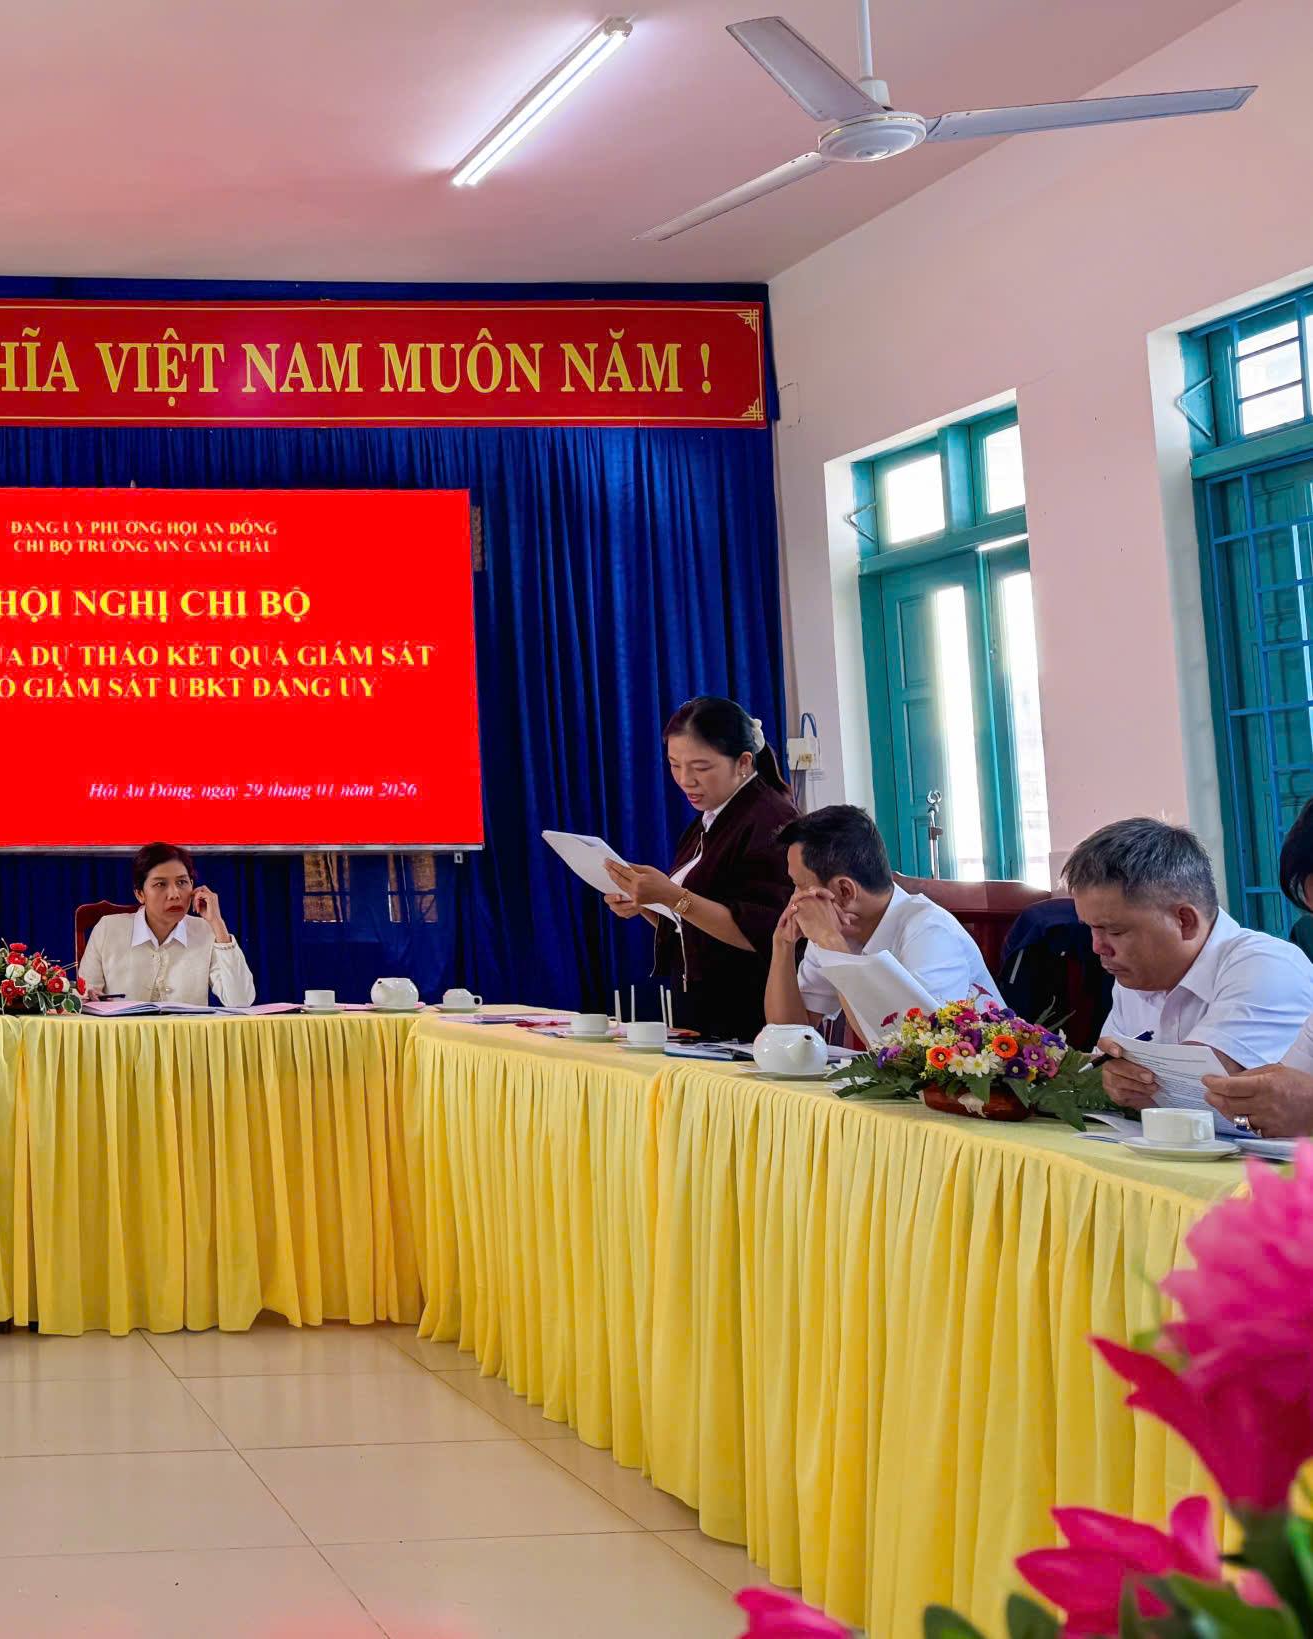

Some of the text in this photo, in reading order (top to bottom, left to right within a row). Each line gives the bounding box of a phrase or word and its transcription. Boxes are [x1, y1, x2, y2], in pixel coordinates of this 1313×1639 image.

[95, 327, 227, 407] VIỆT
[242, 343, 364, 394] NAM
[380, 327, 544, 394] MUÔN
[560, 329, 684, 394] NĂM
[700, 343, 713, 394] !
[205, 523, 224, 534] AN
[13, 540, 44, 552] CHI
[49, 540, 73, 554] BỘ
[73, 590, 169, 623] NGHỊ
[179, 591, 248, 618] CHI
[259, 587, 311, 622] BỘ
[169, 678, 244, 697] UBKT
[243, 784, 264, 798] 29
[379, 783, 417, 798] 2026
